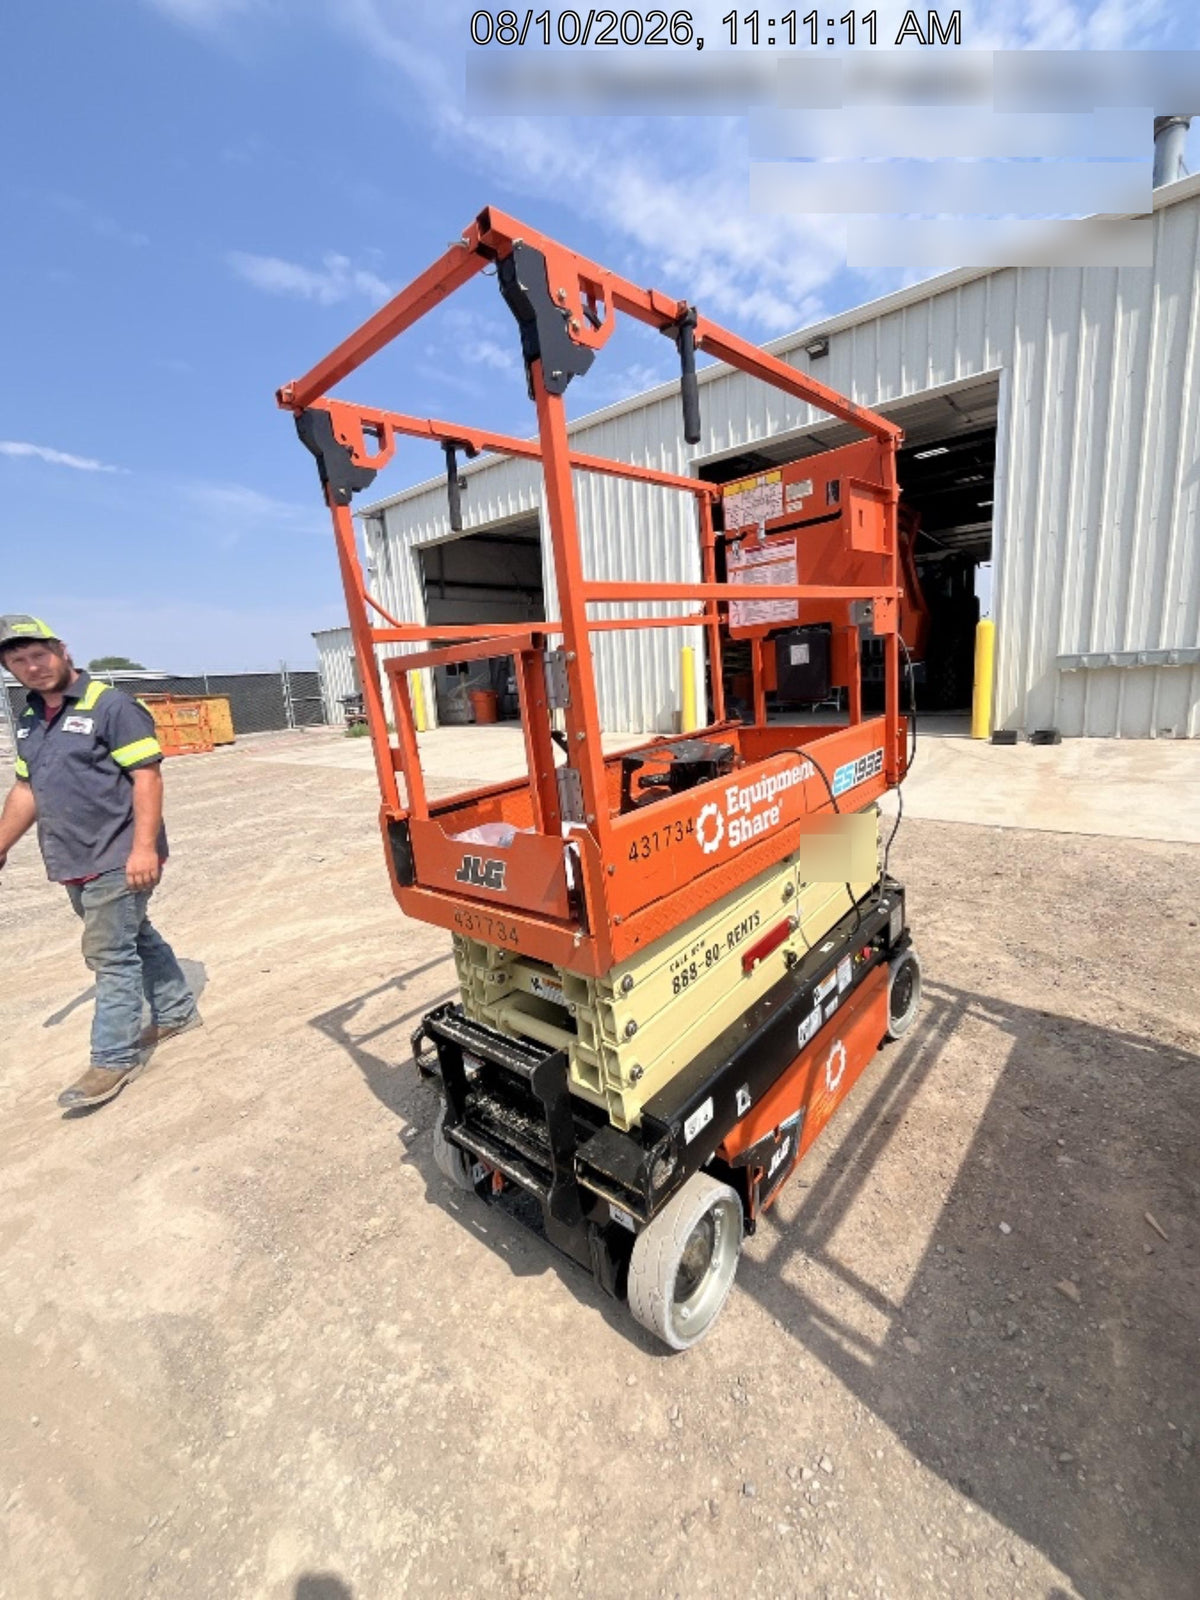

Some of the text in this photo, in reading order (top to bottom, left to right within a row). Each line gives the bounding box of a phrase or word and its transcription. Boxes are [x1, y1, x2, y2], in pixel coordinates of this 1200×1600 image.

[725, 762, 815, 816] Equipment
[833, 749, 883, 796] ES1932
[628, 817, 695, 862] 431734
[727, 807, 780, 848] Share
[455, 855, 507, 891] JLG
[454, 909, 519, 944] 431734
[672, 910, 760, 995] 888-80-RENTS
